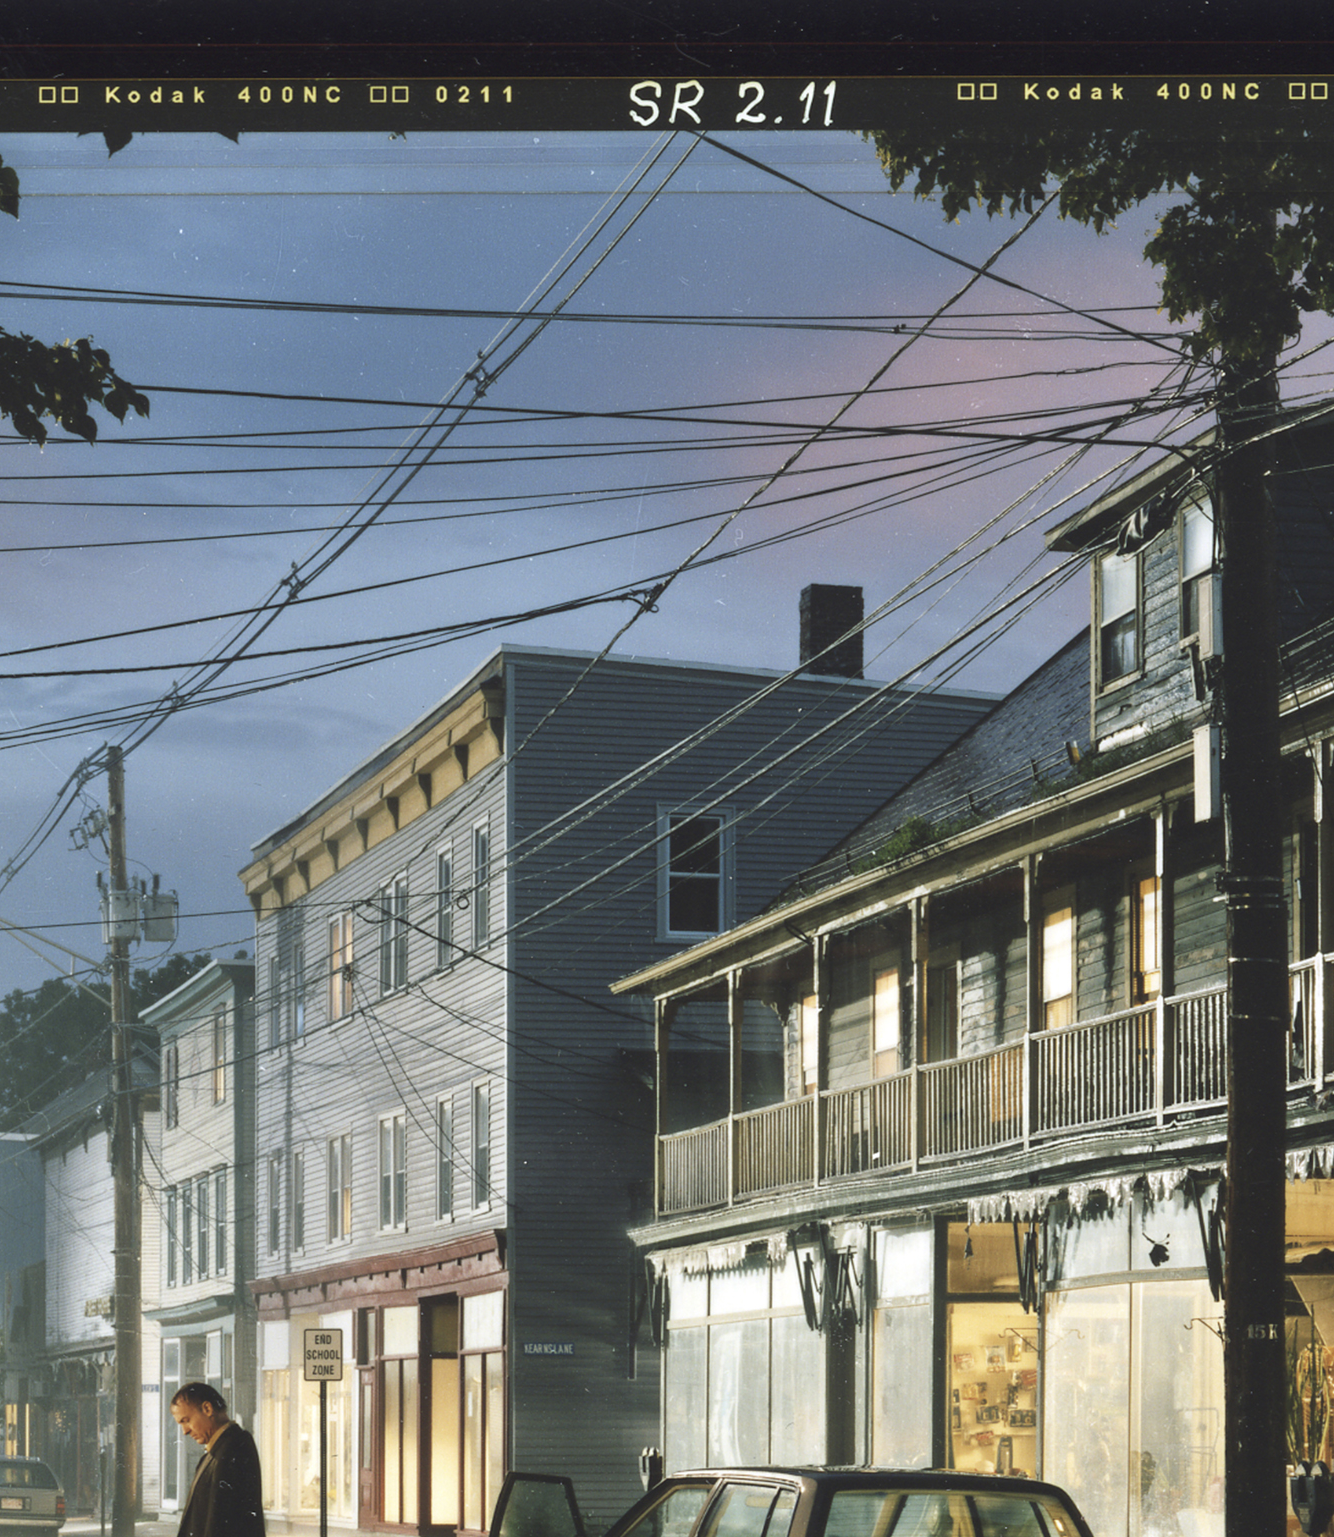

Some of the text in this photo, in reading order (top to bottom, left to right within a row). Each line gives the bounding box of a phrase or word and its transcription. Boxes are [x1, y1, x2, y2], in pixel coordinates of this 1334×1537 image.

[629, 80, 836, 126] SR 2.11
[314, 1334, 332, 1345] END
[306, 1349, 341, 1360] SCHOOL
[312, 1364, 335, 1375] ZONE
